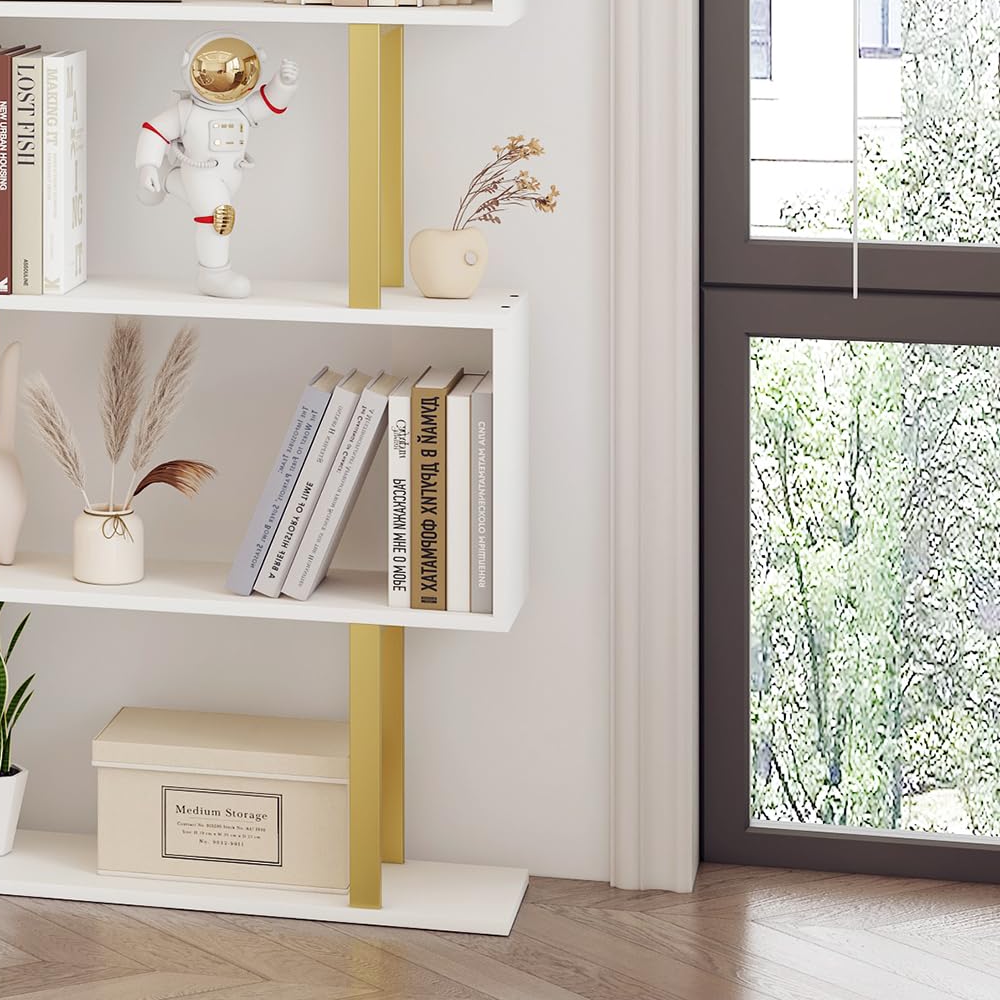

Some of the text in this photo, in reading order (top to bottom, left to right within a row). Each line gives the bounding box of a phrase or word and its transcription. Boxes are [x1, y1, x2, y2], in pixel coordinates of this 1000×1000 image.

[0, 100, 8, 191] NEW URBAN HOUSING
[17, 65, 35, 165] LOST FISH
[175, 804, 268, 822] Medium Storage
